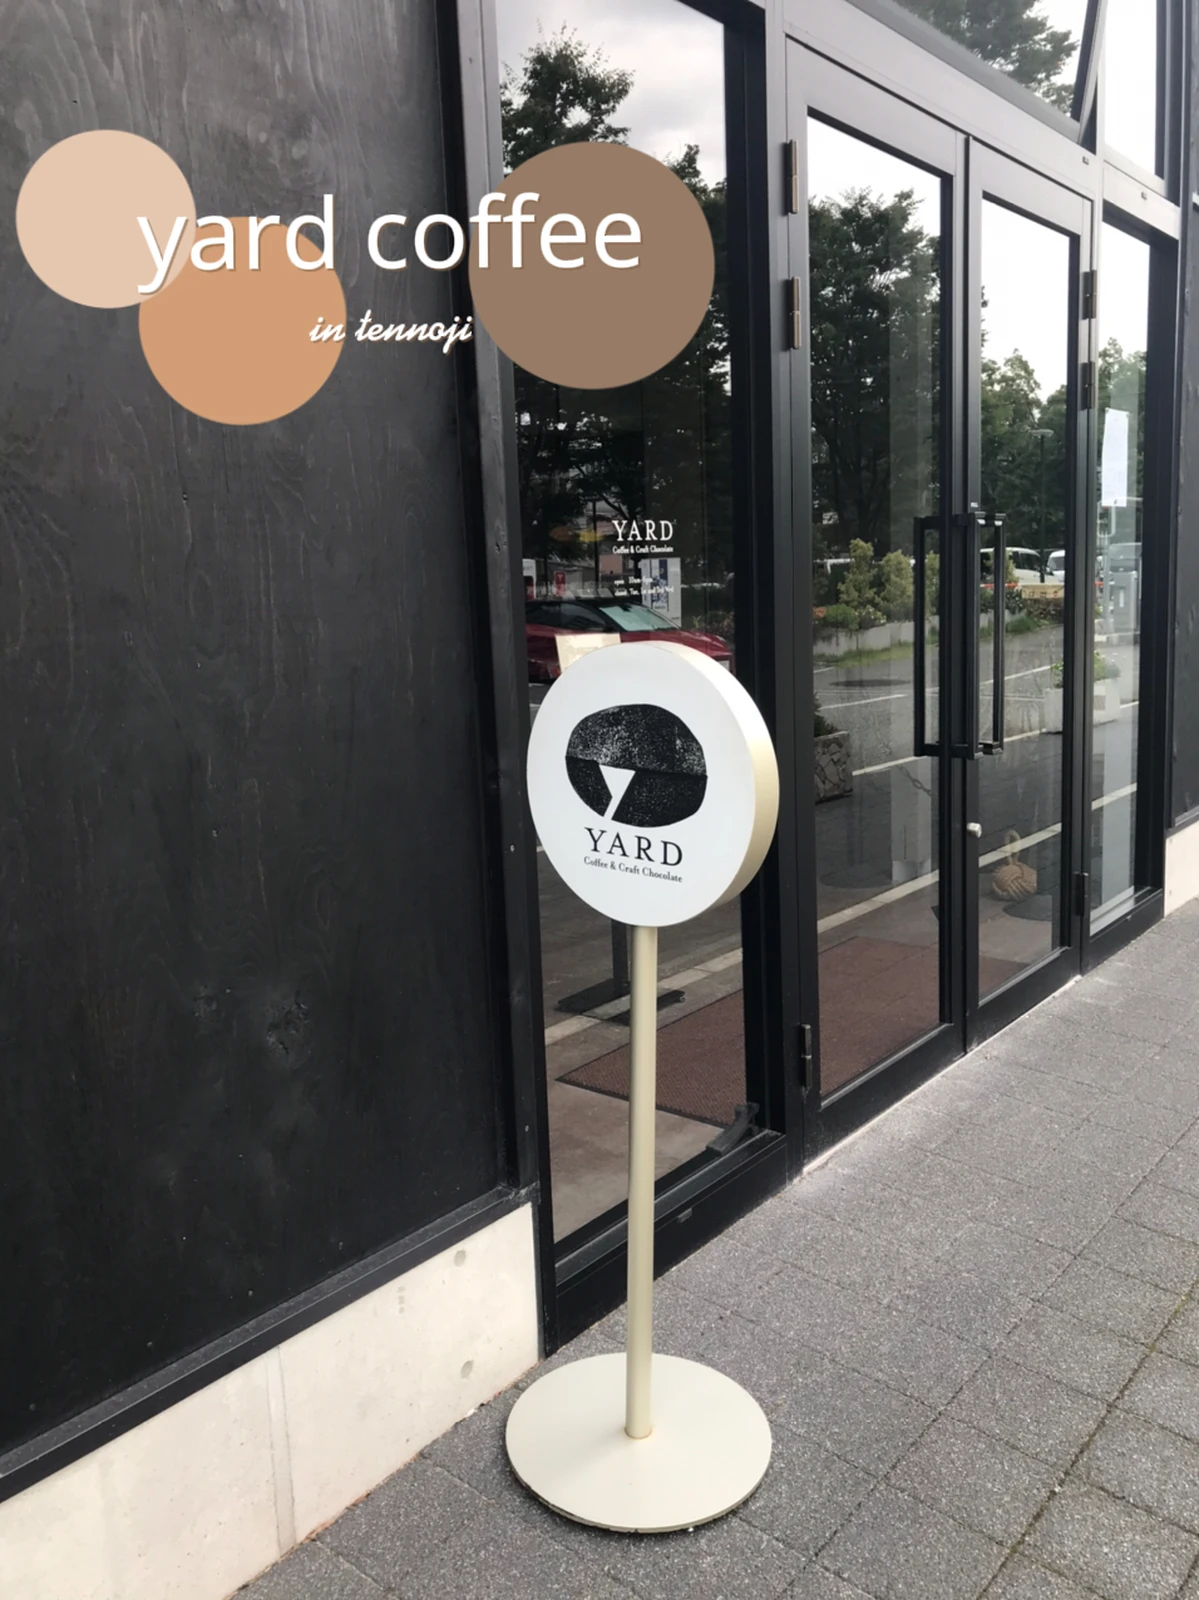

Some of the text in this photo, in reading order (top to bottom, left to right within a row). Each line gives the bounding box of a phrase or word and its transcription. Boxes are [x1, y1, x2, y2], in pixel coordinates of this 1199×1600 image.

[612, 520, 673, 541] YARD
[584, 826, 683, 867] YARD
[583, 855, 683, 883] Coffee & Craft Chocolate
